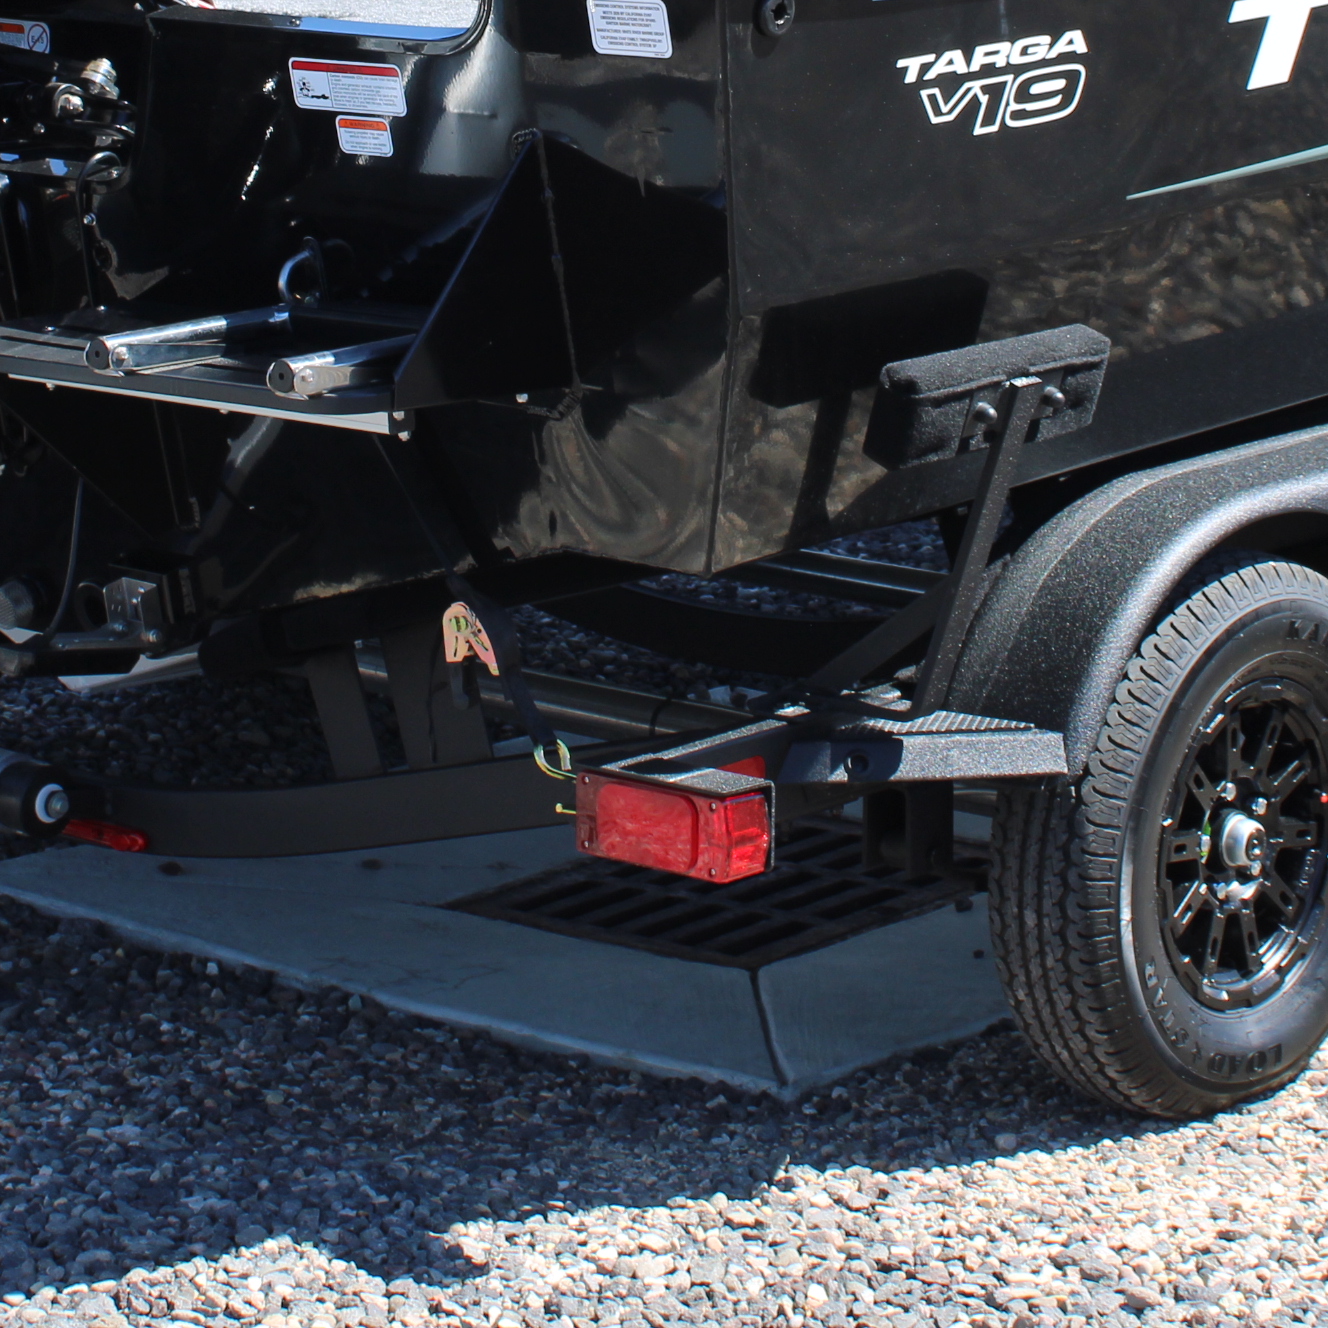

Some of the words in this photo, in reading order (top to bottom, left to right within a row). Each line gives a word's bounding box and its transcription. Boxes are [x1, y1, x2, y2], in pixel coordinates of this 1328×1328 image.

[896, 30, 1088, 84] TARGA
[920, 63, 1086, 136] V19
[1144, 958, 1190, 1048] STAR
[1207, 1043, 1283, 1080] LOAD
